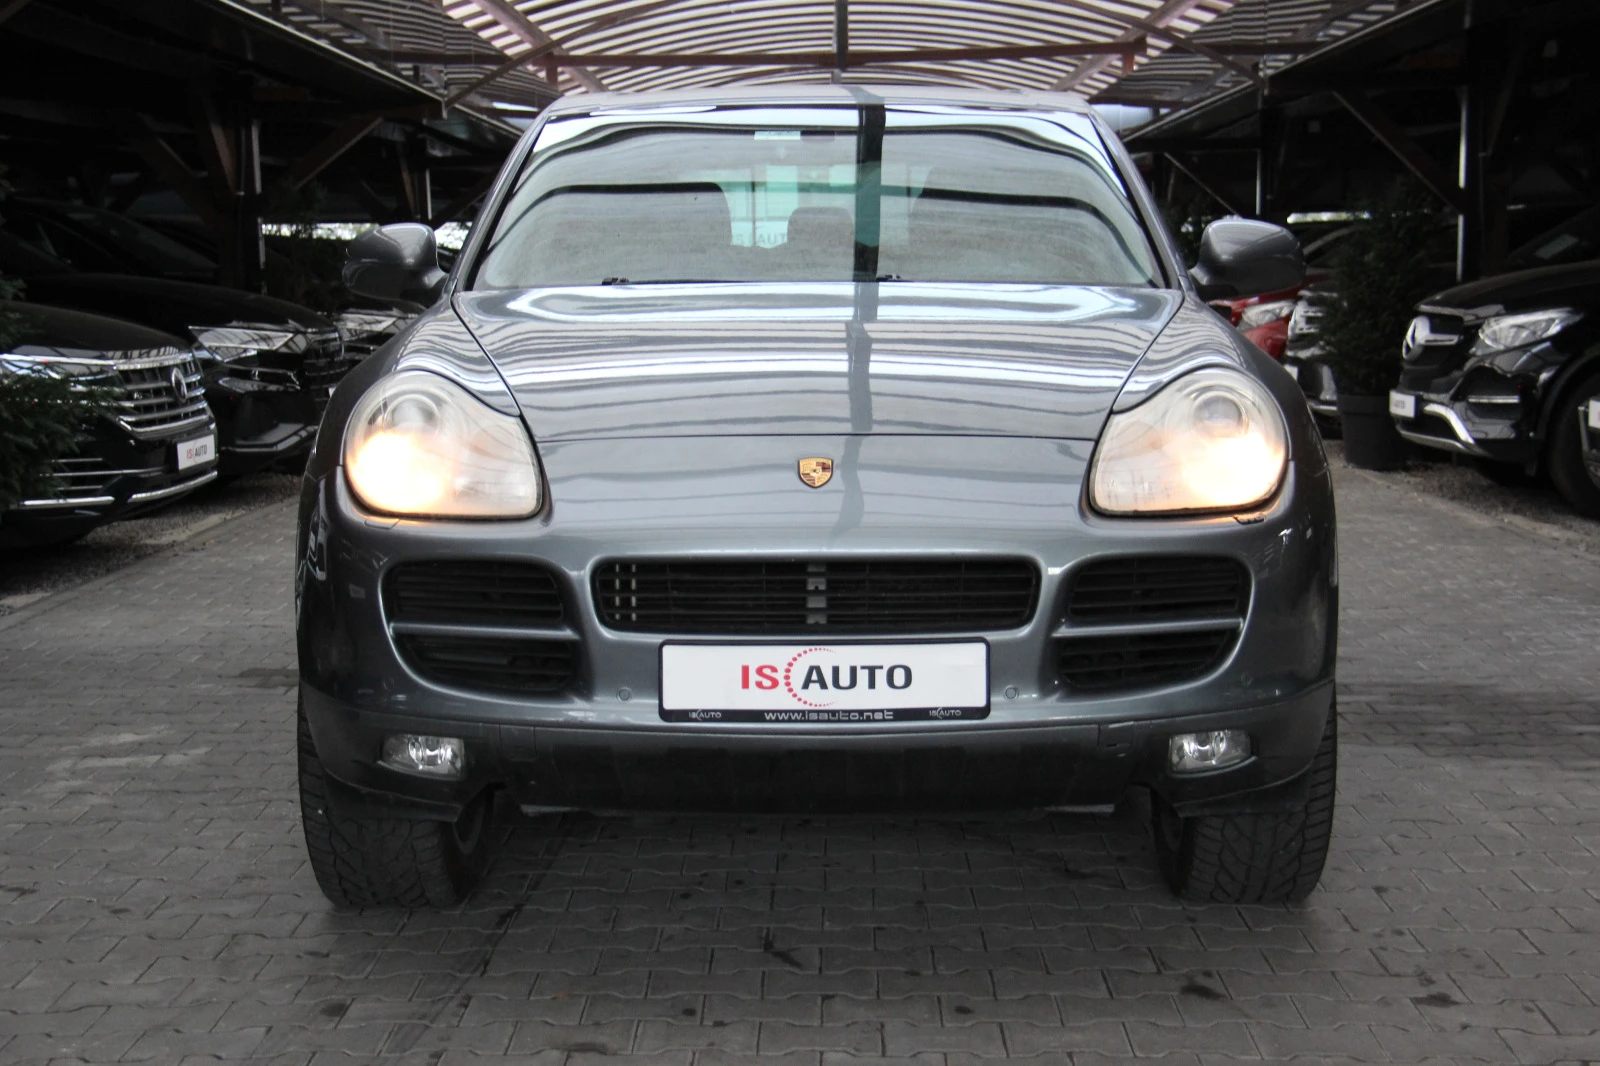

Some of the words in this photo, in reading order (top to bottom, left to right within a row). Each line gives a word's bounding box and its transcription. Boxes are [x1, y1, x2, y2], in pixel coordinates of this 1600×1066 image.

[758, 233, 787, 246] AUT
[195, 444, 207, 456] AUTO
[741, 664, 780, 690] IS
[801, 664, 913, 690] AUTO
[764, 709, 894, 721] www.isauto.net
